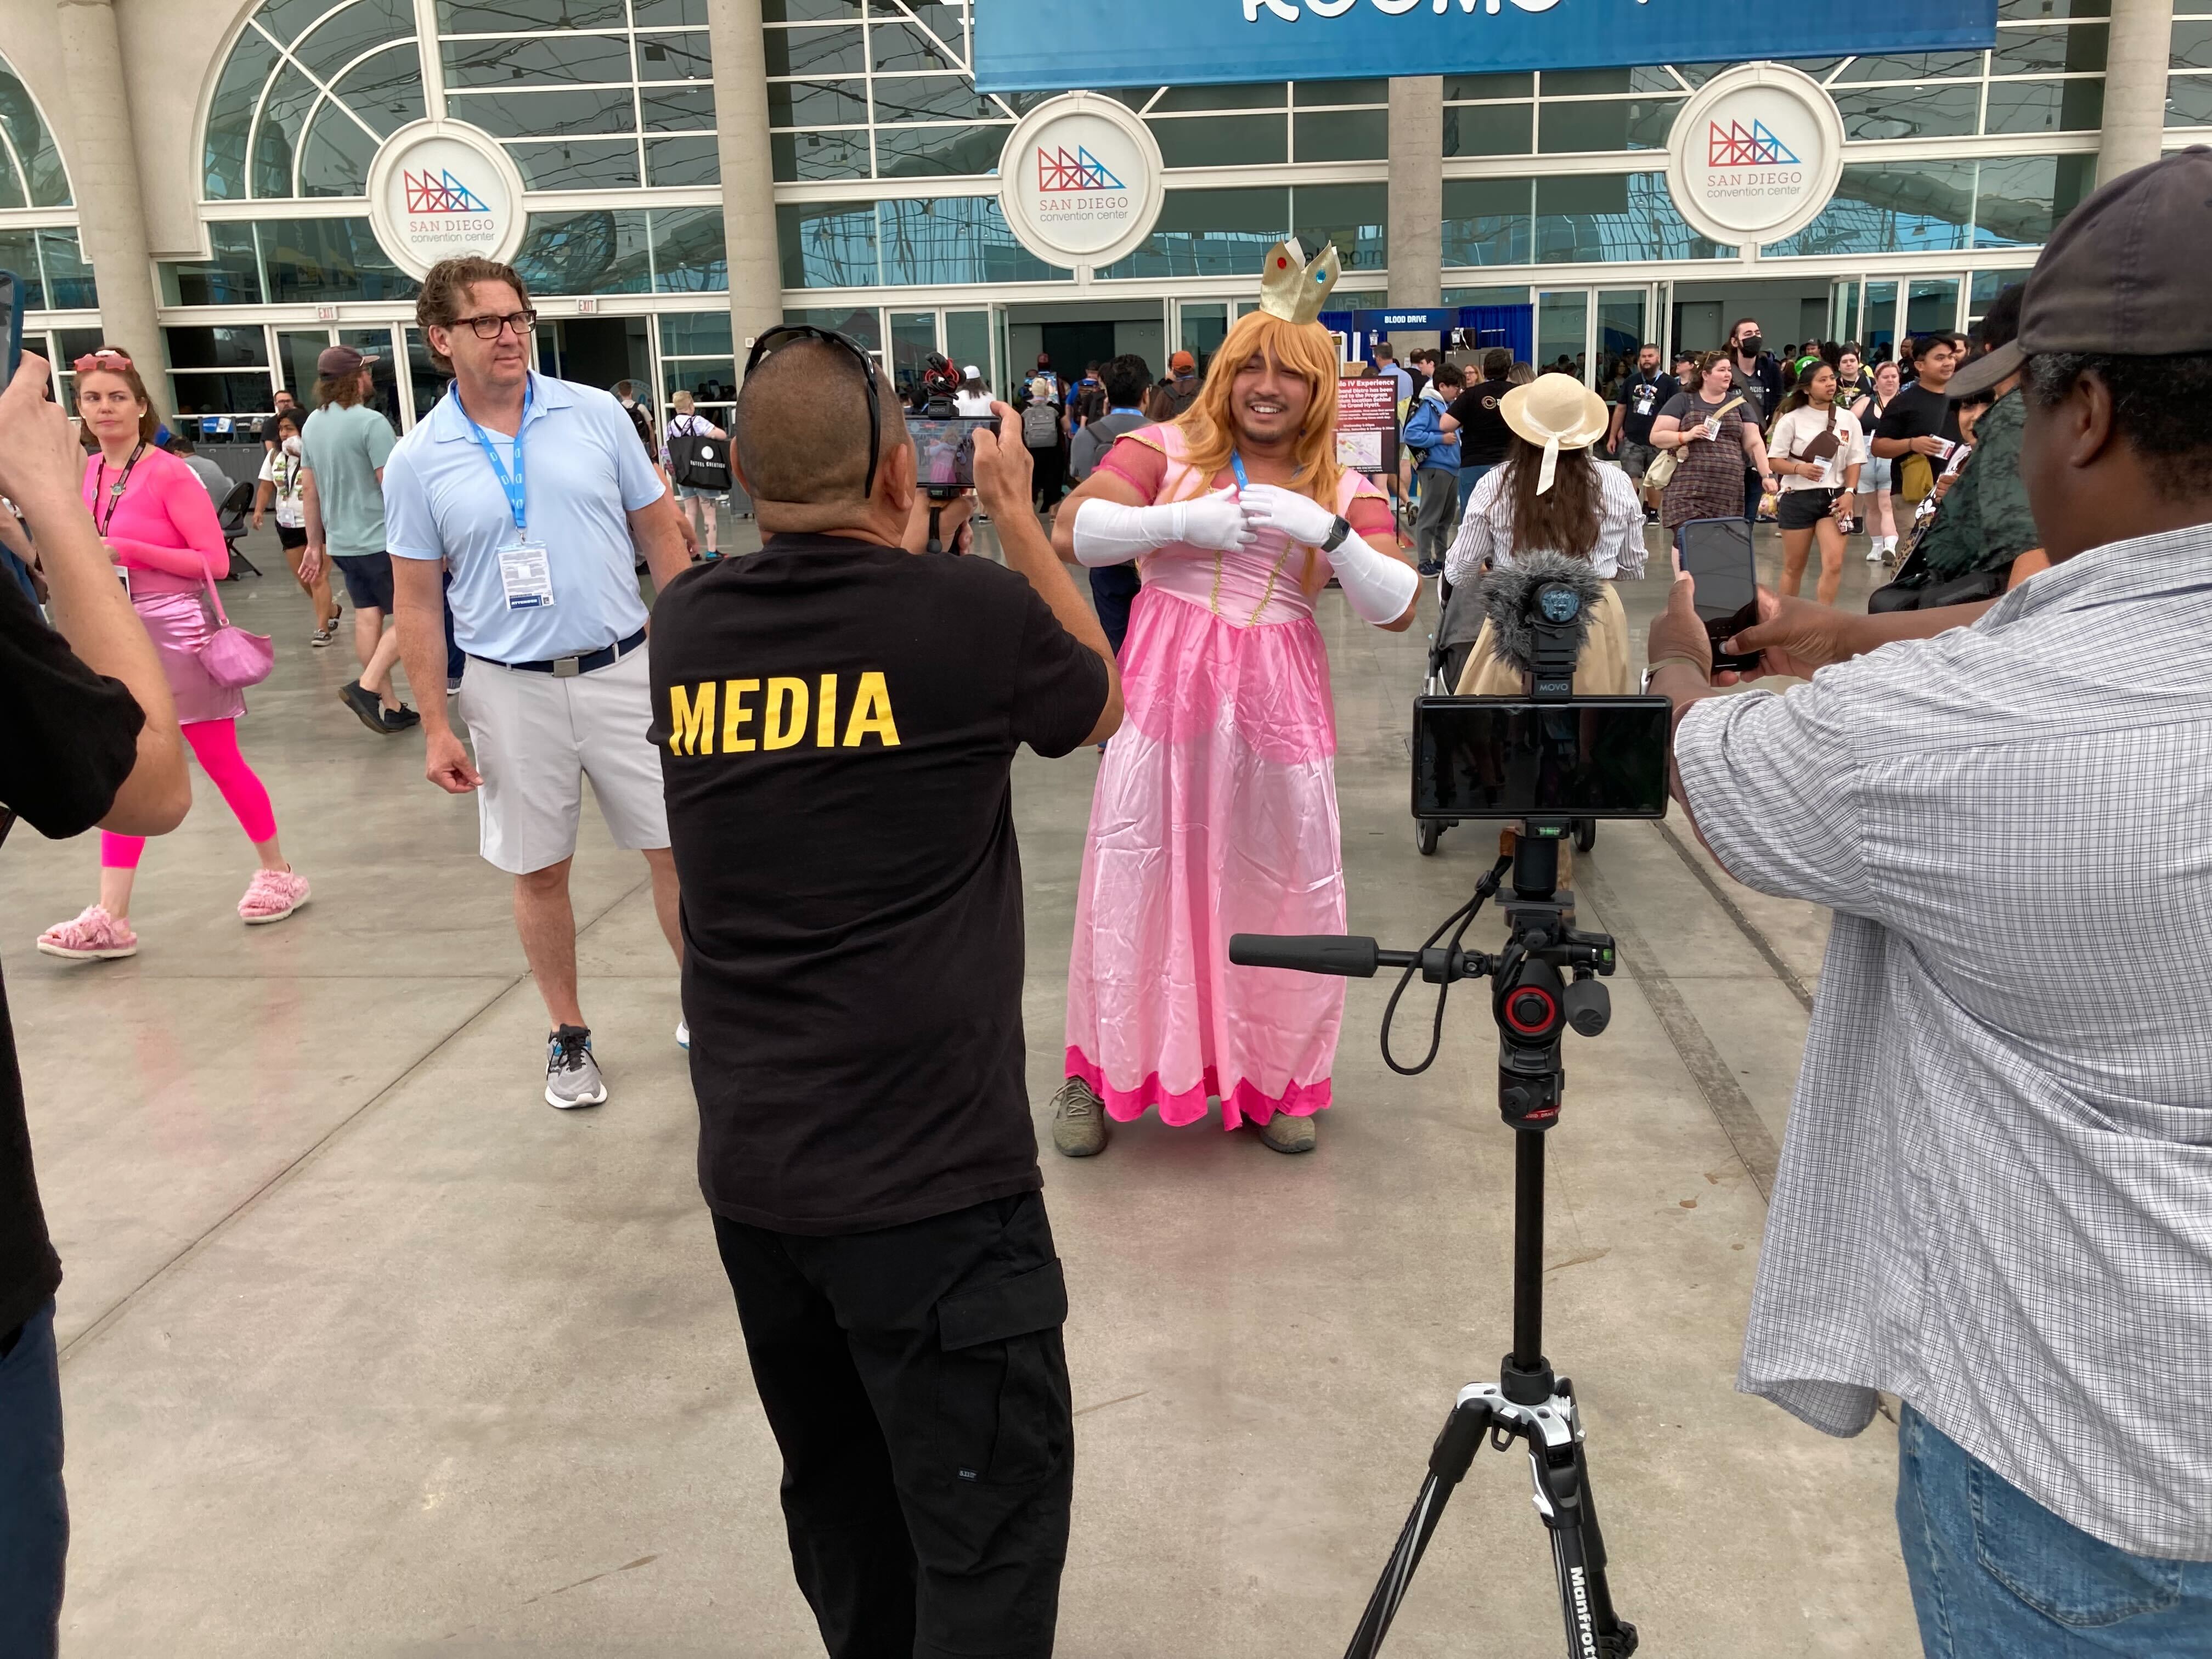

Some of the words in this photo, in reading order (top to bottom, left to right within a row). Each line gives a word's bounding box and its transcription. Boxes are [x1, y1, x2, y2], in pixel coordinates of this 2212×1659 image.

[1707, 174, 1742, 187] SAN
[1748, 172, 1802, 185] DIEGO
[1707, 187, 1764, 198] convention
[1768, 186, 1801, 195] center
[1040, 199, 1071, 211] SAN
[1077, 197, 1128, 209] DIEGO
[1040, 211, 1093, 222] convention
[1097, 210, 1128, 220] center
[410, 221, 439, 232] SAN
[445, 219, 494, 231] DIEGO
[411, 233, 462, 242] convention
[465, 232, 495, 241] center
[579, 300, 594, 312] EXIT
[318, 307, 333, 319] EXIT
[1384, 315, 1406, 324] BLOOD
[1407, 315, 1426, 323] DRIVE
[1356, 380, 1395, 388] Experience
[669, 671, 901, 757] MEDIA
